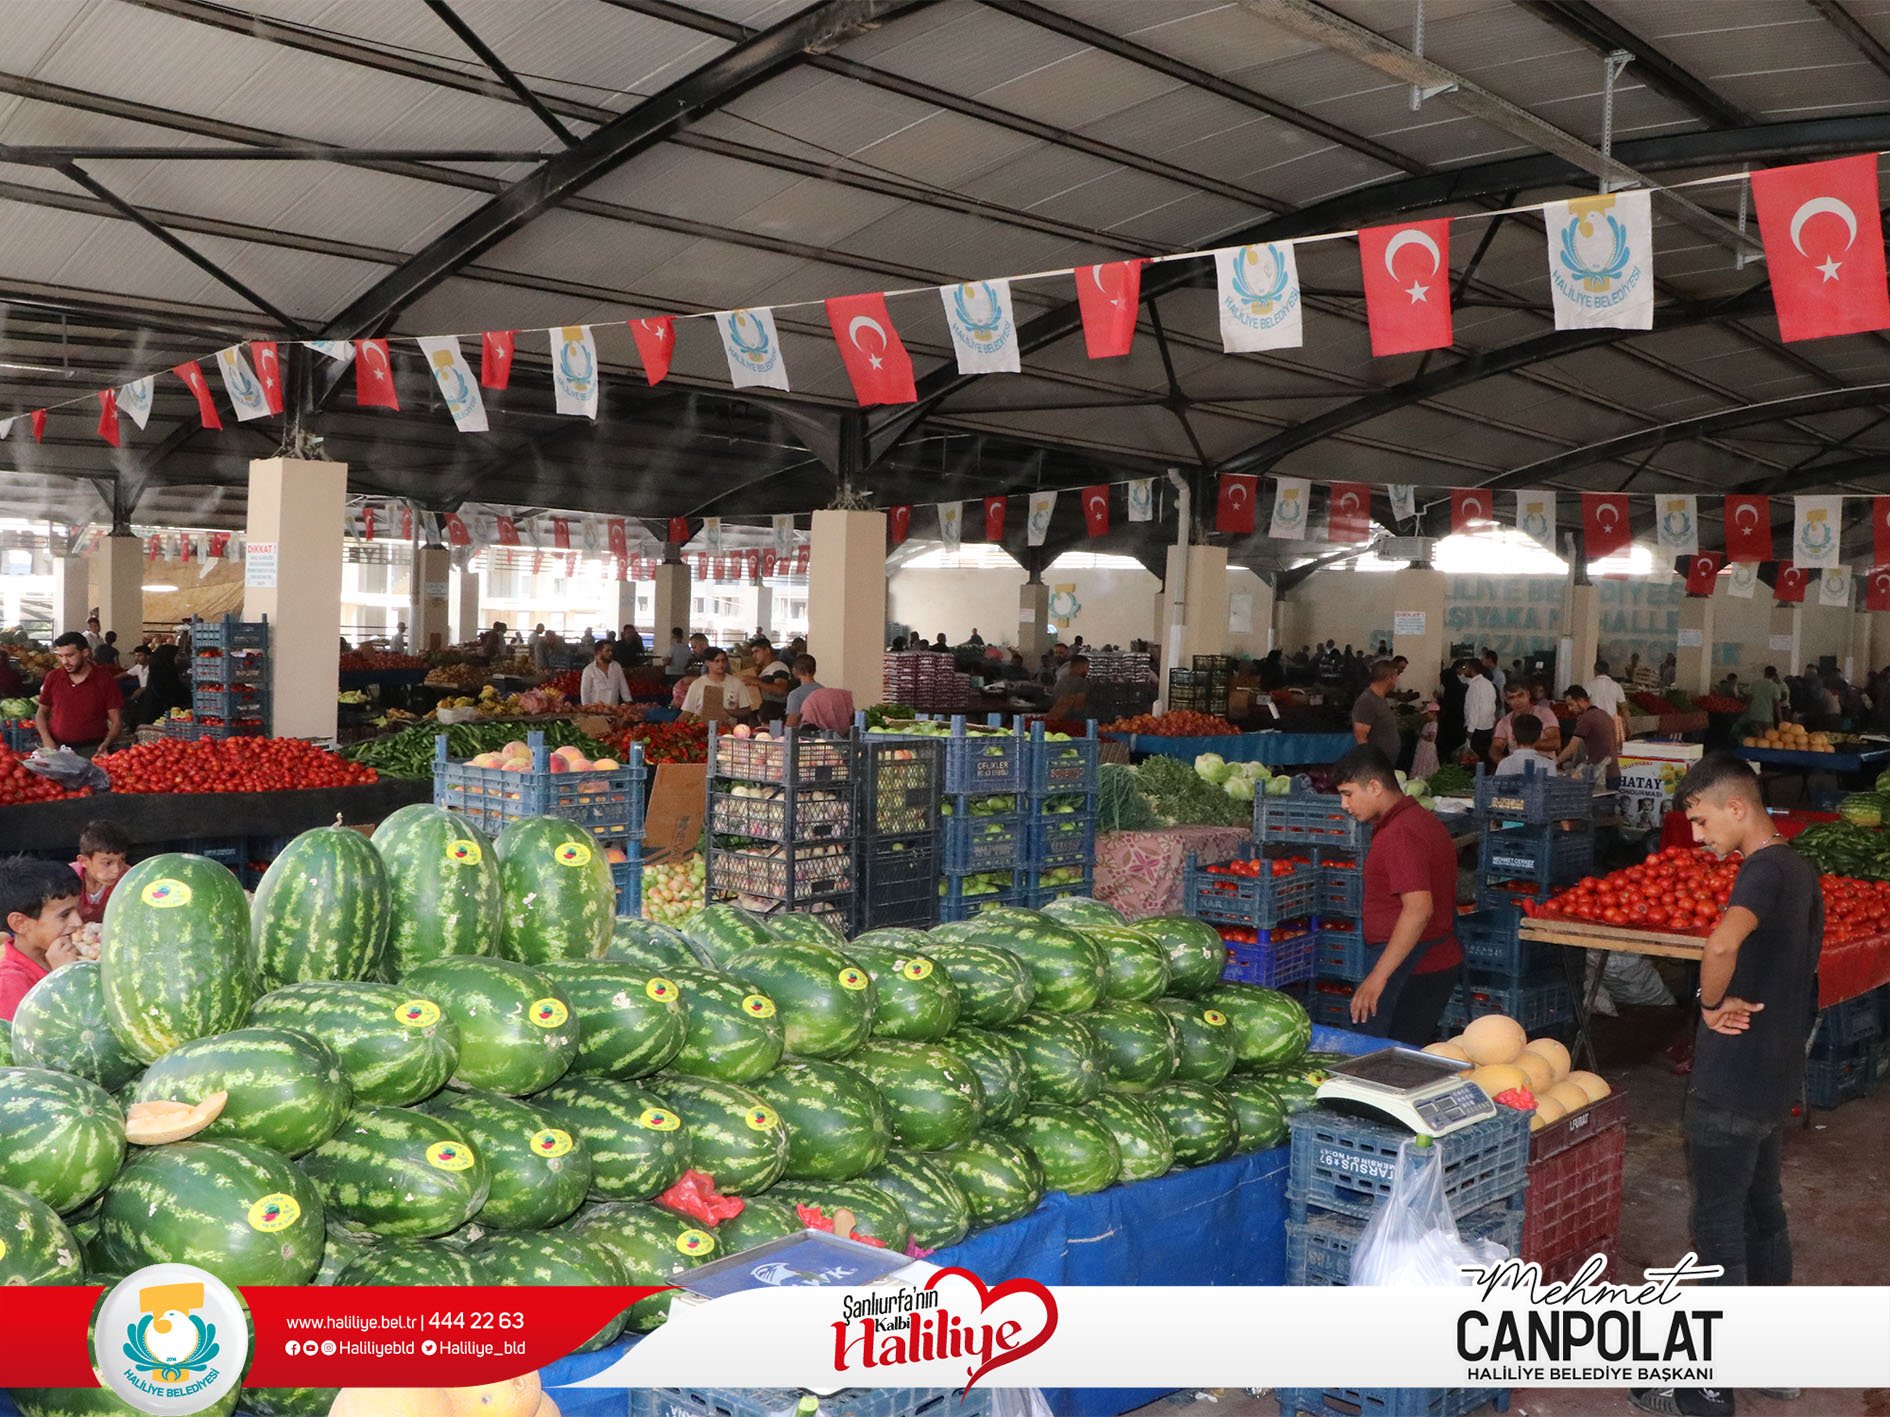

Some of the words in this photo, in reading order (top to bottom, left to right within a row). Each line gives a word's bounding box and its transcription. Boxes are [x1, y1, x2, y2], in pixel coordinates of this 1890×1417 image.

[1552, 270, 1592, 308] HALİLİYE
[1594, 265, 1641, 309] BELEDİYESİ
[1224, 296, 1259, 329] HALİLİYE
[247, 544, 272, 553] DİKKAT
[1620, 776, 1662, 789] HATAY
[1619, 788, 1663, 798] ONDURMASI
